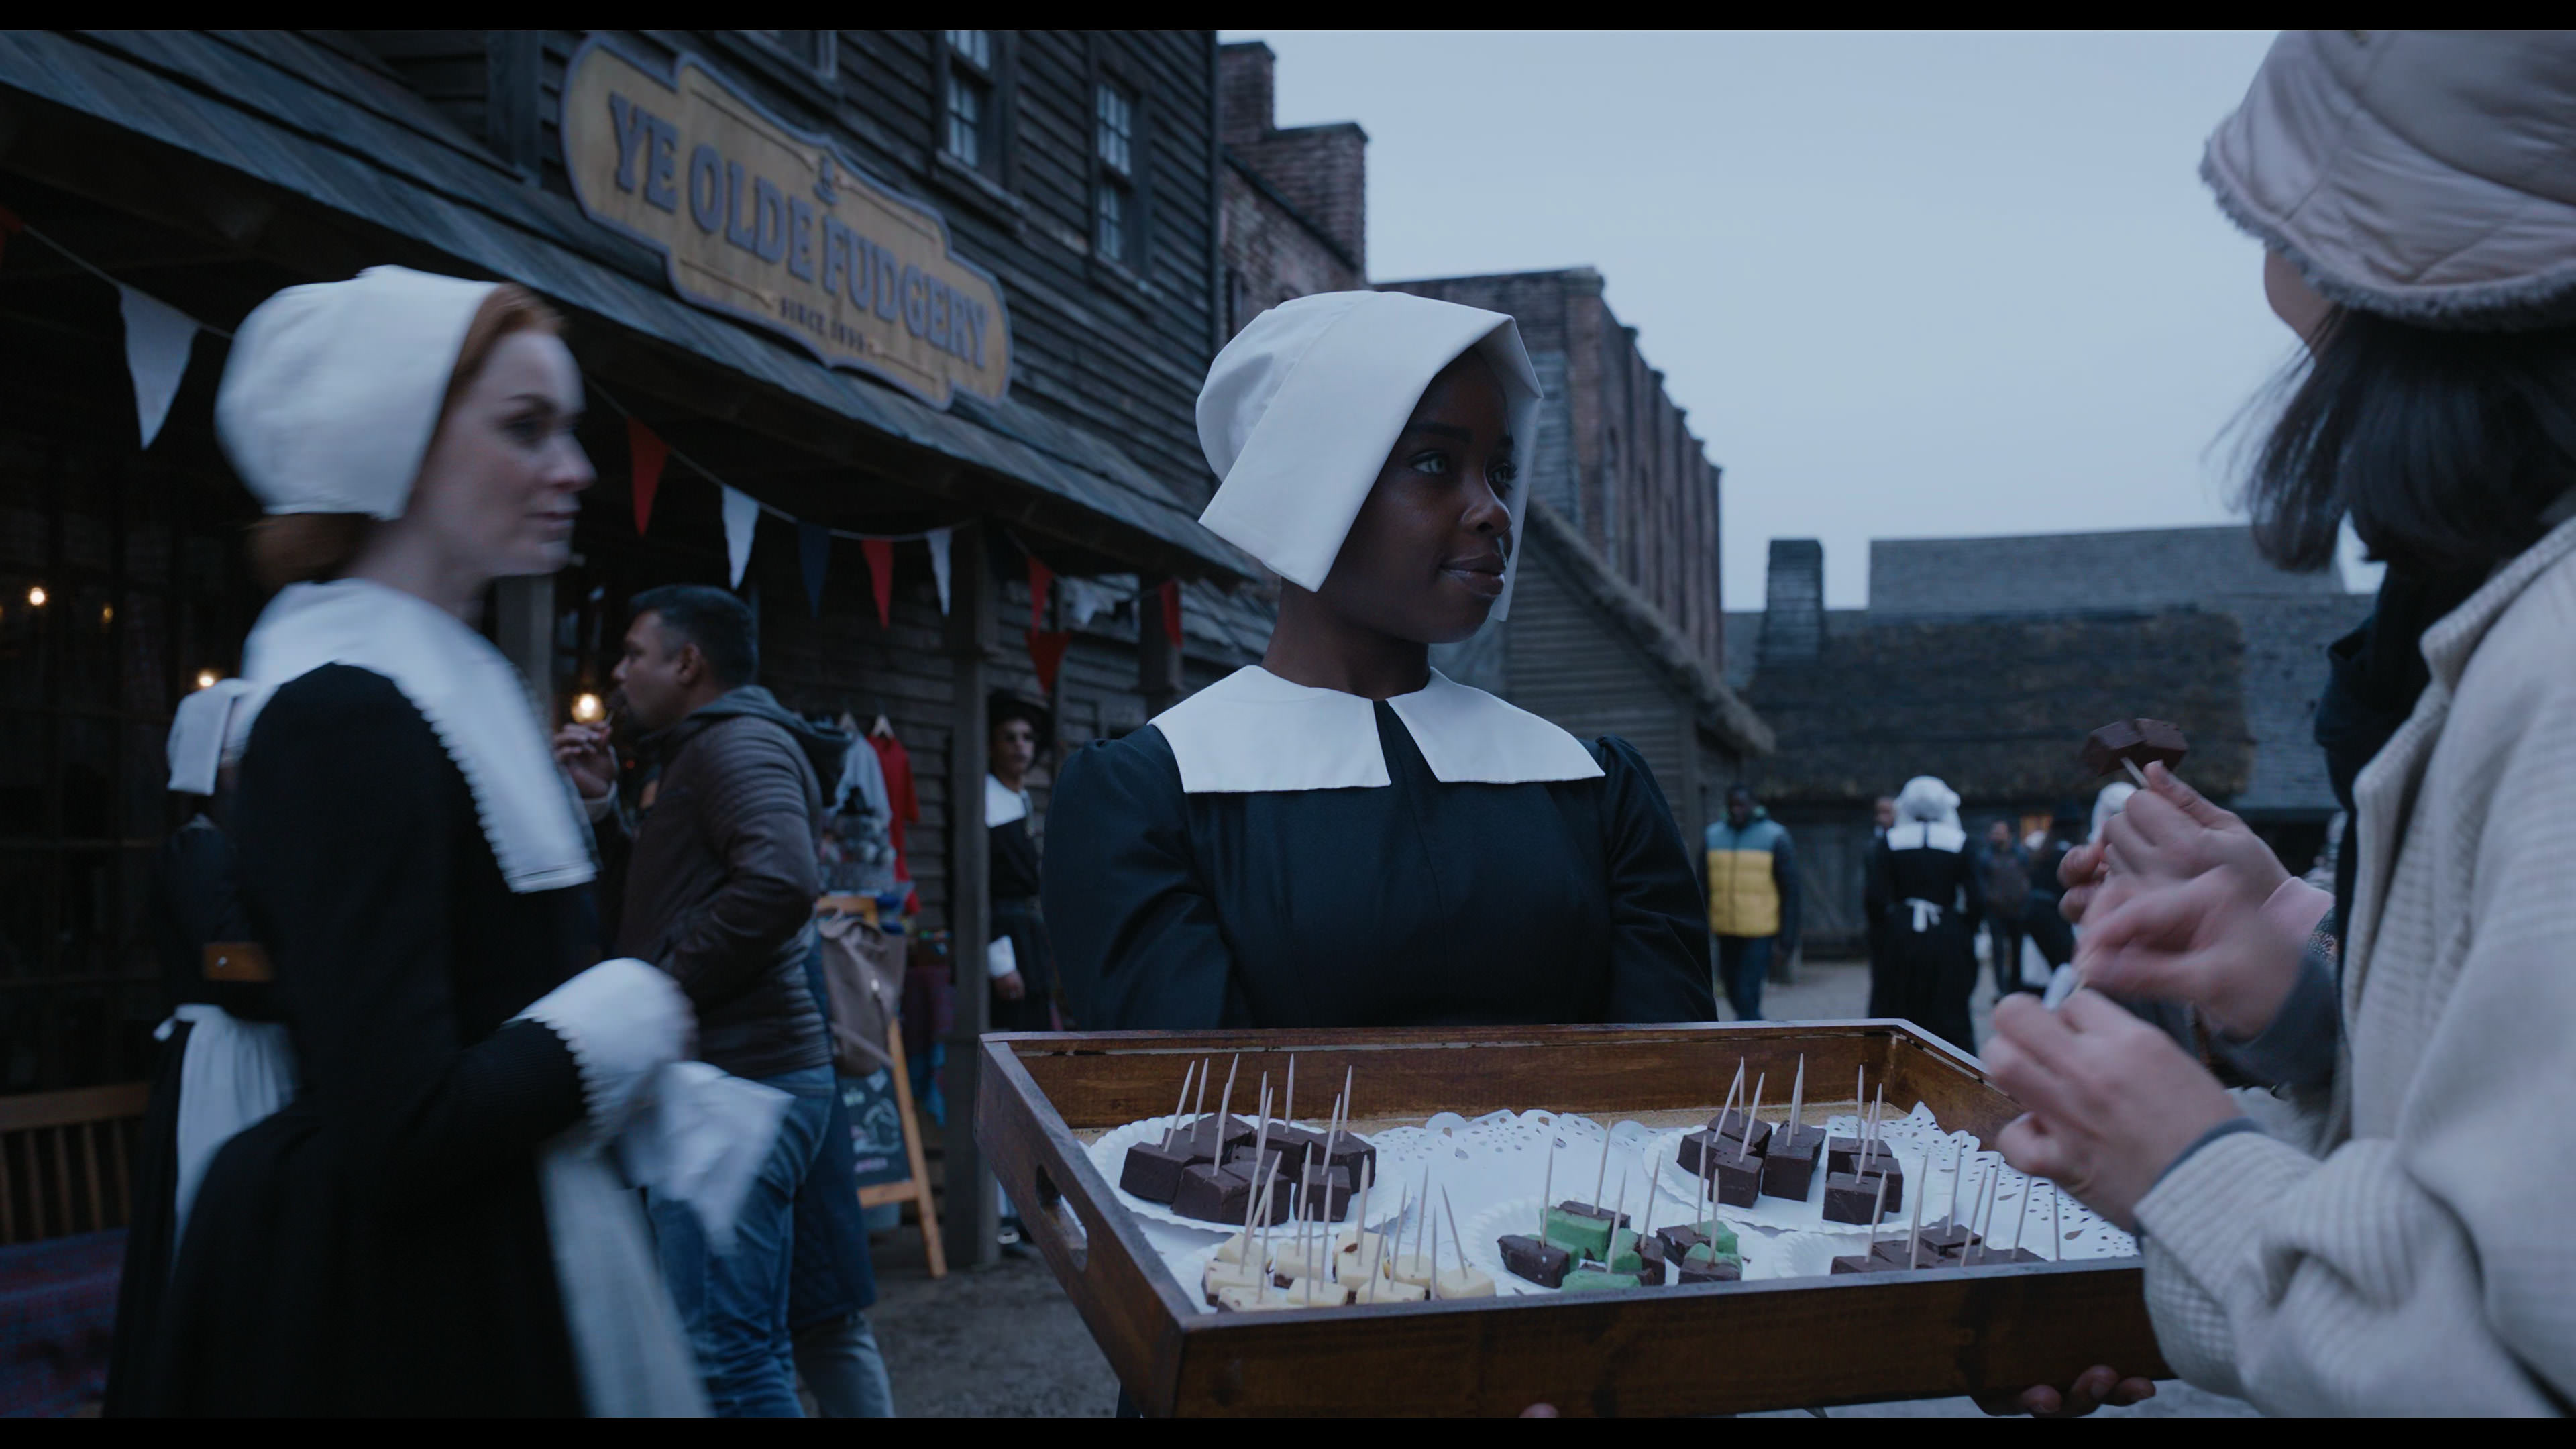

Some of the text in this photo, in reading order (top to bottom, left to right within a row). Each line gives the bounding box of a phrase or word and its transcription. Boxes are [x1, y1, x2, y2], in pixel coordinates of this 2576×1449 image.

[609, 92, 989, 368] YE OLDE FUDGERY
